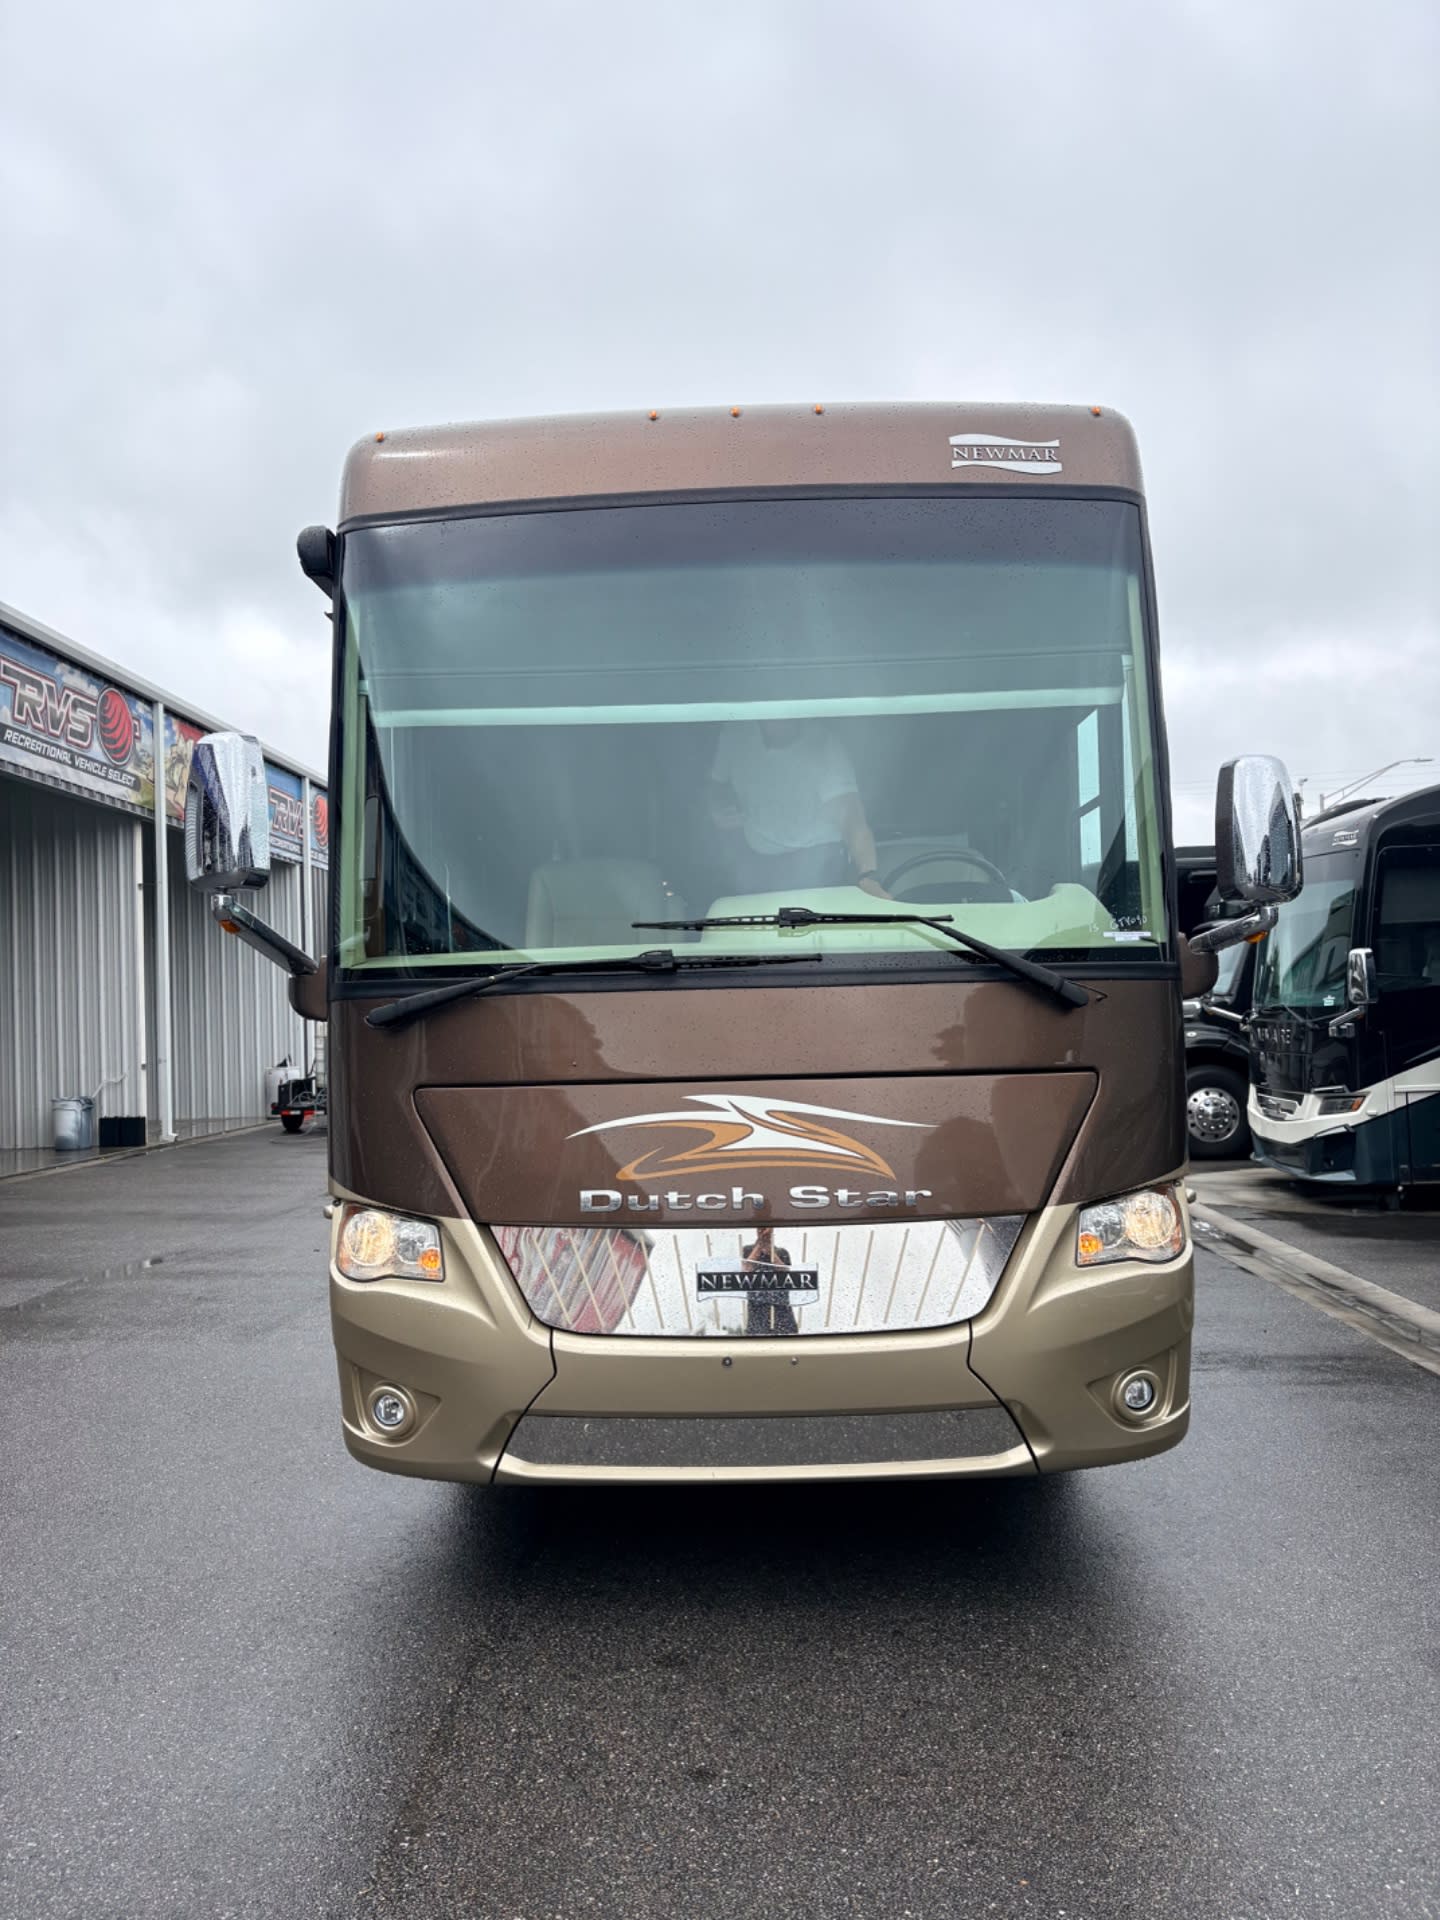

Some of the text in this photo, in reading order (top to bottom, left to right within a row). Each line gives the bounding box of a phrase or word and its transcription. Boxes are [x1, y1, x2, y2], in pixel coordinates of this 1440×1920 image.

[952, 446, 1058, 461] NEWMAR
[0, 653, 98, 751] RVS
[4, 728, 137, 787] RECREATIONAL VEHICLE SELECT
[579, 1185, 933, 1213] Dutch Star
[700, 1273, 816, 1290] NEWMAR
